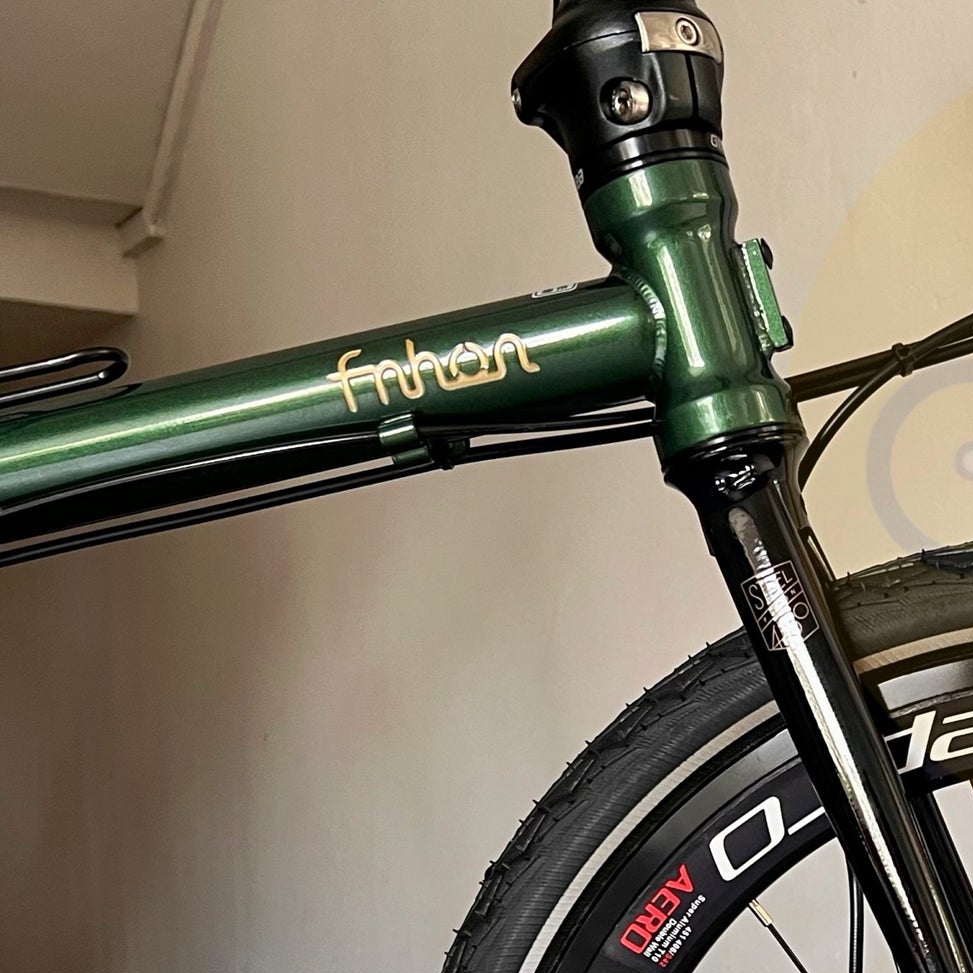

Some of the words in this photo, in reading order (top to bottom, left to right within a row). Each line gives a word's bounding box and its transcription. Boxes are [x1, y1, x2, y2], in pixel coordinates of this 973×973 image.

[326, 333, 540, 413] fnhon
[620, 864, 694, 954] AERO
[686, 894, 706, 918] Super
[654, 917, 677, 942] Double
[643, 941, 659, 958] Wall
[651, 948, 666, 963] T10
